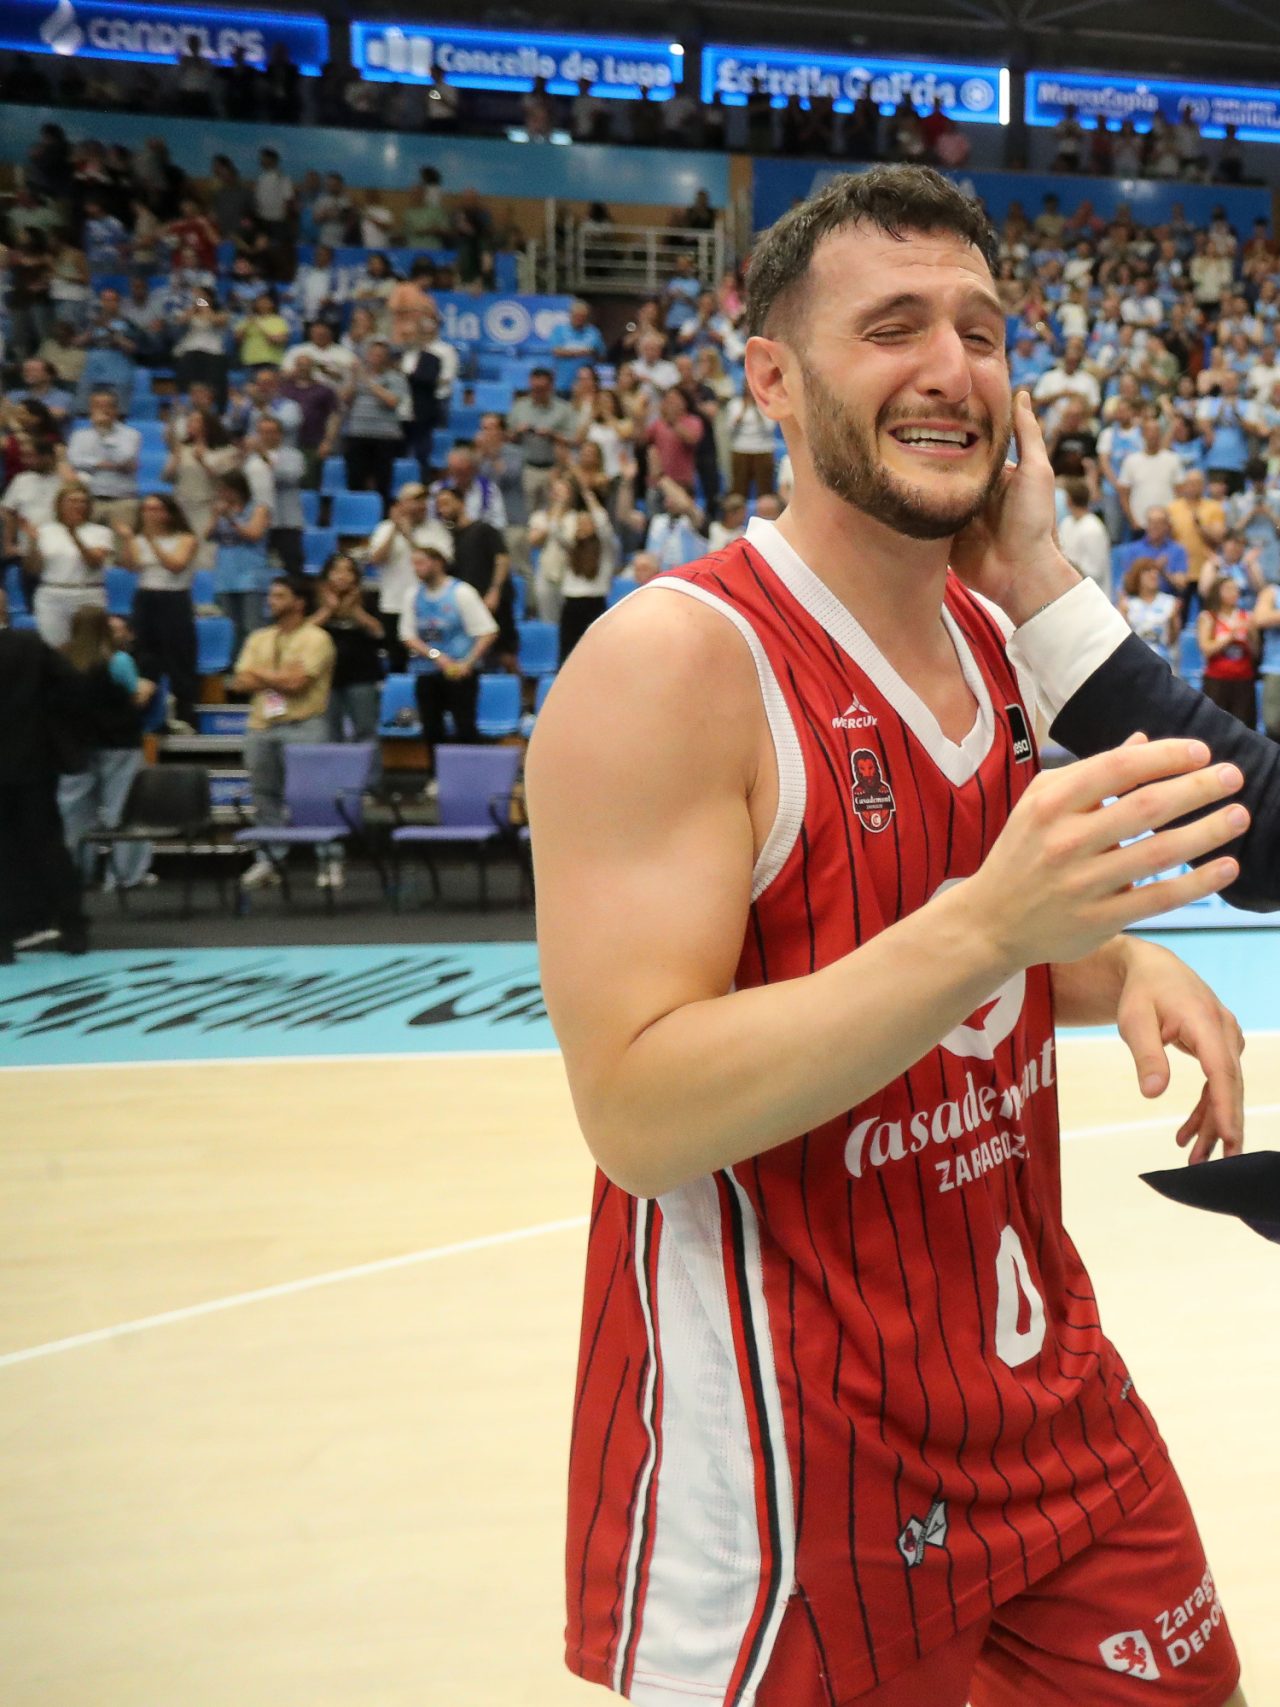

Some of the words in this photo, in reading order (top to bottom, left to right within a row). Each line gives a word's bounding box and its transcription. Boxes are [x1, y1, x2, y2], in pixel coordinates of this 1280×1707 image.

[436, 42, 556, 79] Concello
[560, 50, 598, 82] de
[603, 55, 671, 88] Lugo
[717, 58, 842, 97] Estrella
[934, 1130, 1030, 1193] ZARAGOZ
